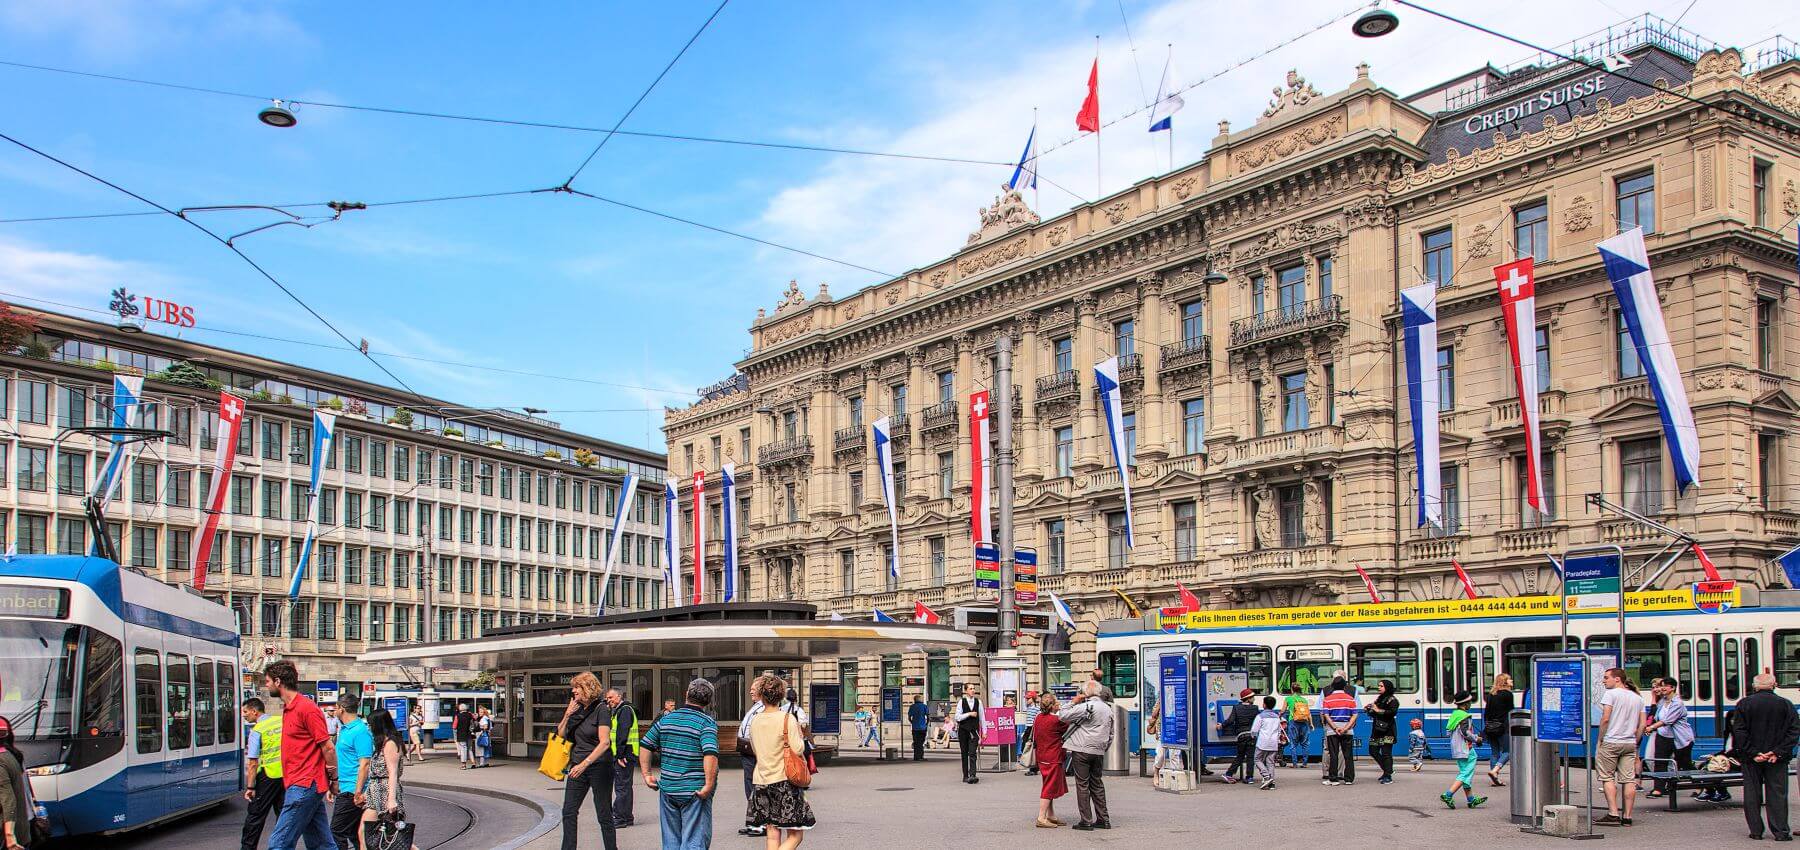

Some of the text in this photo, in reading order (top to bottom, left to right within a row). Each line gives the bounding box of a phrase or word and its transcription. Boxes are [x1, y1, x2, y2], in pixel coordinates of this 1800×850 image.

[1465, 76, 1607, 134] CREDIT SUISSE
[144, 296, 195, 328] UBS
[1565, 569, 1601, 577] Paradeplatz
[1570, 586, 1578, 594] 11
[0, 590, 58, 608] nbach
[1192, 614, 1211, 622] Falls
[1214, 614, 1236, 622] Ihnen
[1239, 612, 1265, 621] dieses
[1268, 612, 1289, 620] Tram
[1291, 610, 1320, 620] gerade
[1340, 609, 1354, 617] der
[1358, 608, 1380, 617] Nase
[1383, 606, 1434, 617] abgefahren
[1437, 605, 1449, 613] ist
[1460, 603, 1484, 612] 0444
[1487, 602, 1505, 611] 444
[1508, 601, 1527, 610] 444
[1530, 600, 1548, 609] und
[1642, 595, 1687, 606] gerufen.
[1287, 651, 1294, 659] 7
[997, 715, 1014, 726] Blick
